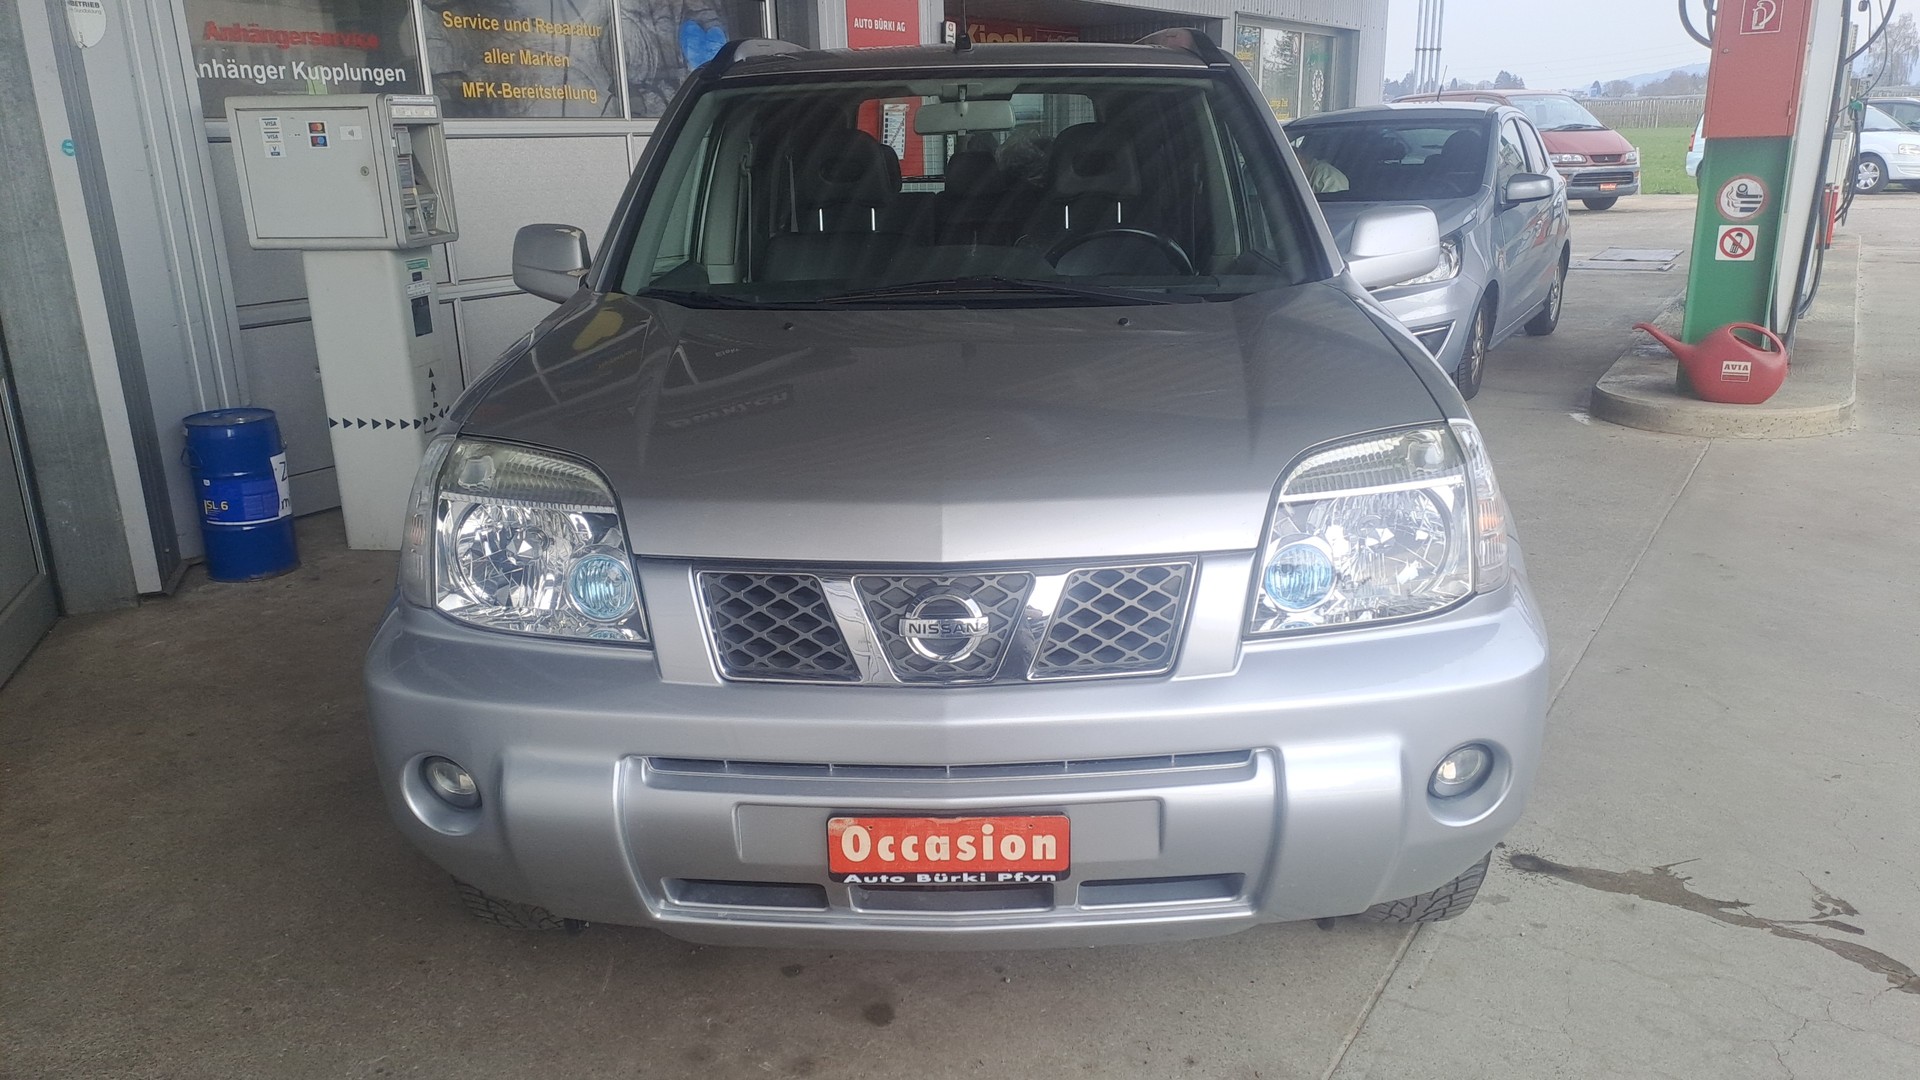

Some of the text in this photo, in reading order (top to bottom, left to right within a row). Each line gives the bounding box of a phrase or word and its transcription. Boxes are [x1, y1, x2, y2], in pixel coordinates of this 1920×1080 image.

[442, 11, 601, 37] Service und Reparatur
[854, 17, 906, 32] AUTO BÜRKI AG
[204, 21, 380, 49] Anhängerservice
[484, 49, 570, 67] aller Marken
[195, 59, 407, 86] nhänger Kupplungen
[462, 81, 598, 103] MFK-Bereitstellung
[1724, 363, 1749, 371] AVIA
[908, 623, 979, 635] NISSAN
[841, 823, 1057, 862] Occasion
[843, 871, 1056, 884] Auto Bürki Pfyn
